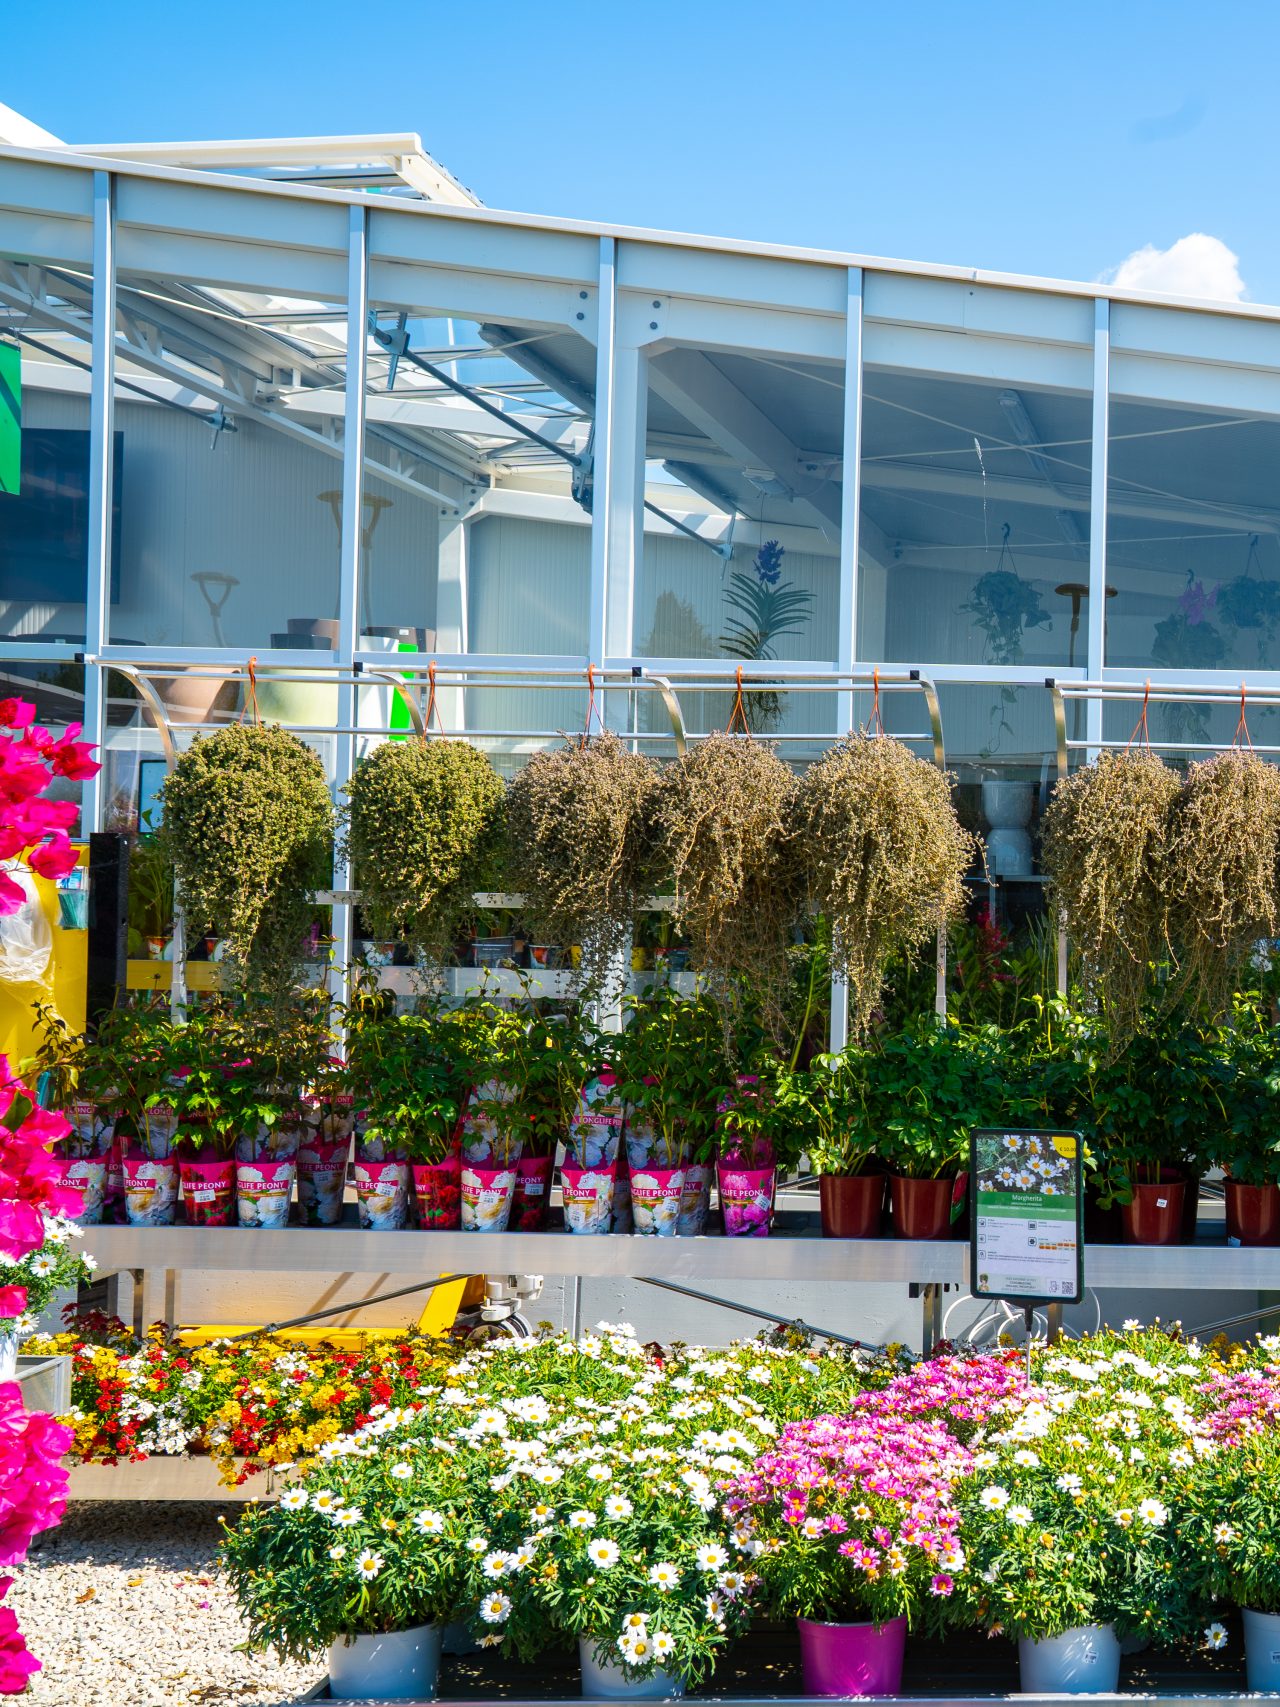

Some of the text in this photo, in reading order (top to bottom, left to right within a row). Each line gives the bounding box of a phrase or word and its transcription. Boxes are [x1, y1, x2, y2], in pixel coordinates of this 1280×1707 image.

[58, 1179, 81, 1187] EONY
[198, 1181, 227, 1190] PEONY
[256, 1182, 284, 1190] PEONY
[566, 1189, 590, 1197] PEONY
[652, 1188, 678, 1197] PEONY
[739, 1189, 765, 1197] PEONY
[1011, 1194, 1043, 1202] Margherita
